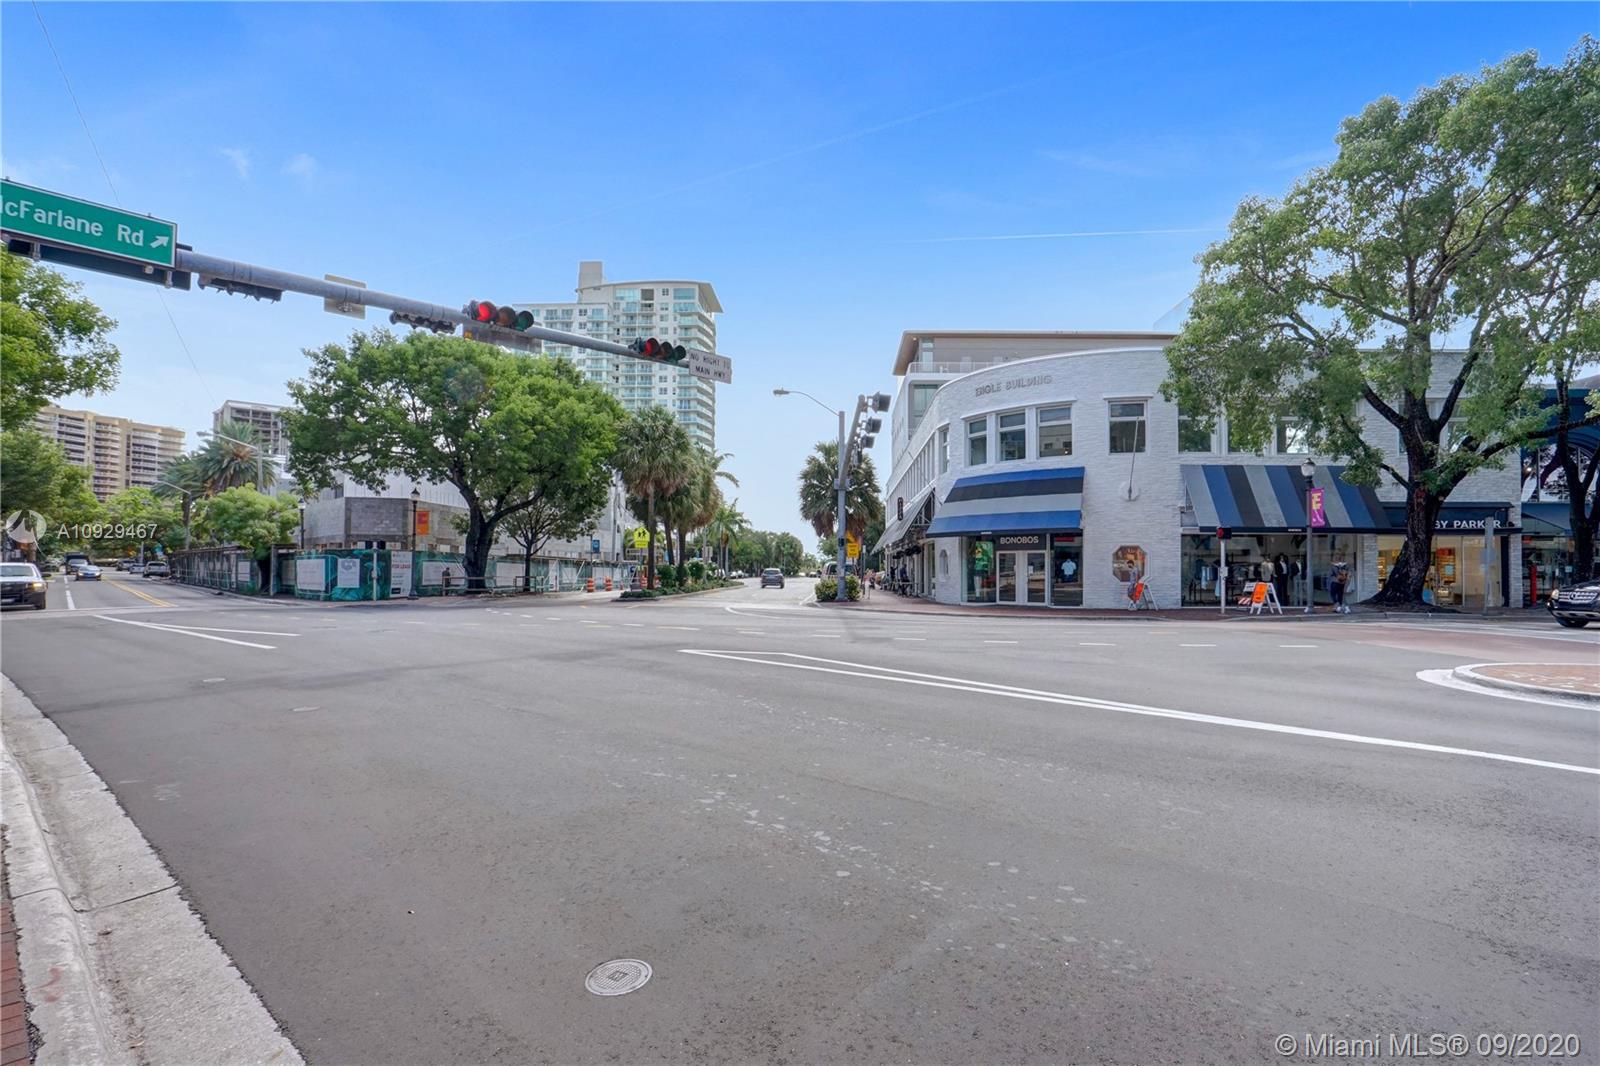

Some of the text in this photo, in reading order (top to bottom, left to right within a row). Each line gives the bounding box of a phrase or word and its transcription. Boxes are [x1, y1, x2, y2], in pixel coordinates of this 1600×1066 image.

[0, 194, 144, 247] cFarlane Rd
[690, 352, 700, 362] NO
[703, 355, 720, 367] RIGHT
[695, 365, 726, 379] MAIN HWY
[1005, 375, 1053, 391] BUILDING
[1453, 520, 1501, 529] PARKR
[1000, 536, 1040, 545] BONOBOS
